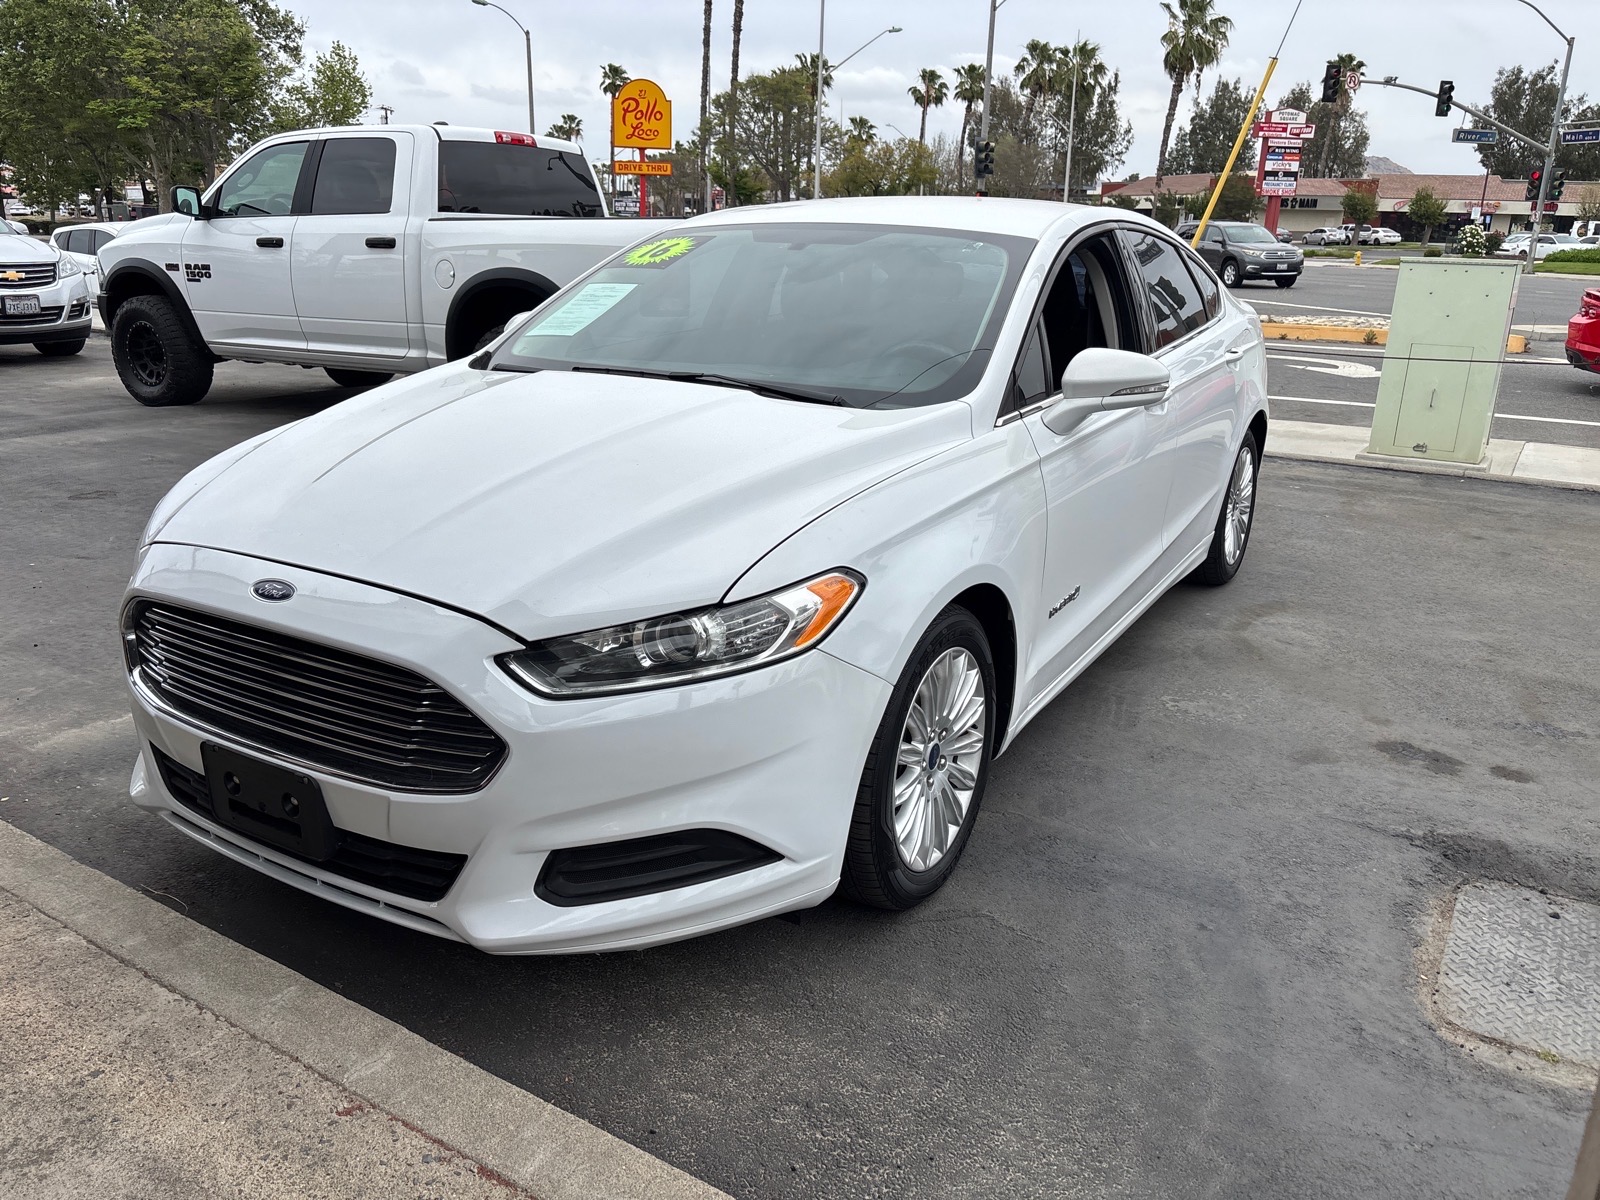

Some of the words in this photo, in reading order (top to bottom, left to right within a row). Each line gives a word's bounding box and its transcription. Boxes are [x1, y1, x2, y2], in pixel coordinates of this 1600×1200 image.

[638, 89, 647, 99] El
[621, 97, 663, 126] Pollo
[626, 122, 659, 141] Loco
[1298, 198, 1318, 208] MAIN
[258, 583, 286, 597] Ford
